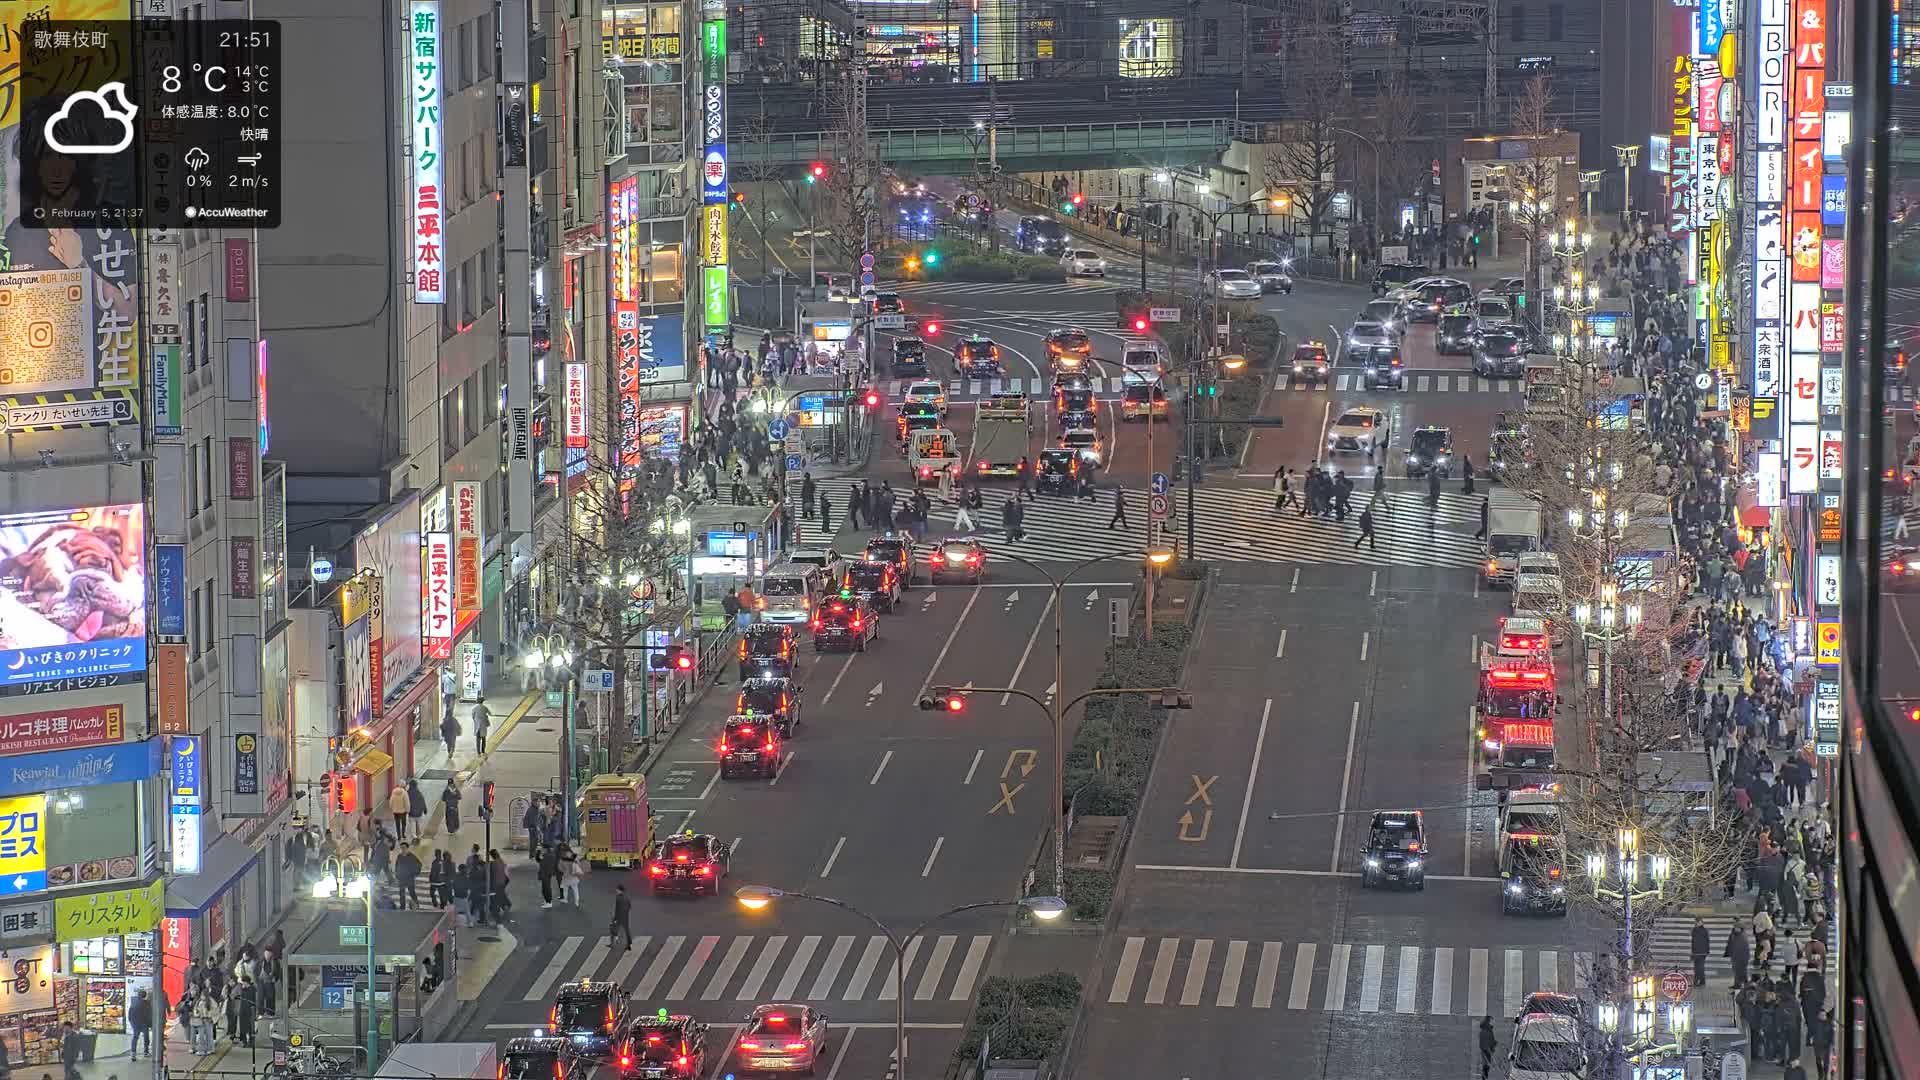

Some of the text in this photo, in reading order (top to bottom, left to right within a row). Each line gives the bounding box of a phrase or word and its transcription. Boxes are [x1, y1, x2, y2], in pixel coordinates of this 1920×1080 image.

[1706, 0, 1718, 46] ントラル
[617, 39, 645, 57] 祝日
[651, 37, 680, 55] 夜間
[1674, 54, 1692, 136] パチンコ
[1703, 87, 1717, 121] アコム
[708, 86, 721, 139] もつなべ
[414, 12, 440, 292] 新宿サンパーク 三平本館
[706, 161, 723, 177] 薬
[1672, 147, 1691, 233] エスパス
[710, 208, 722, 264] 肉汁水餃子
[709, 276, 722, 314] レイク
[1823, 305, 1833, 313] 6F
[619, 332, 636, 389] ラーメン
[1757, 331, 1772, 382] 大衆酒場
[155, 354, 168, 415] FamilyMart
[1793, 309, 1818, 470] パセラ
[12, 404, 110, 421] テンクリ たいせい先生
[1827, 406, 1840, 415] 5F
[513, 407, 528, 461] HOMEGAME
[460, 487, 470, 531] GAME
[1826, 497, 1837, 506] 3F
[431, 543, 448, 630] 三平ストア
[372, 581, 381, 620] 389
[27, 644, 133, 666] いびきのクリニック
[431, 638, 443, 646] B1
[23, 674, 119, 694] リアエイド ビジョン
[466, 681, 476, 690] 4F
[108, 711, 118, 737] 5F
[164, 721, 181, 731] B2
[24, 735, 68, 748] RESTAURANT
[0, 811, 38, 835] プロ
[179, 806, 193, 814] 2F
[0, 837, 39, 858] ミス
[3, 911, 39, 932] 囲碁
[68, 903, 141, 929] クリスタル
[326, 991, 341, 1005] 12
